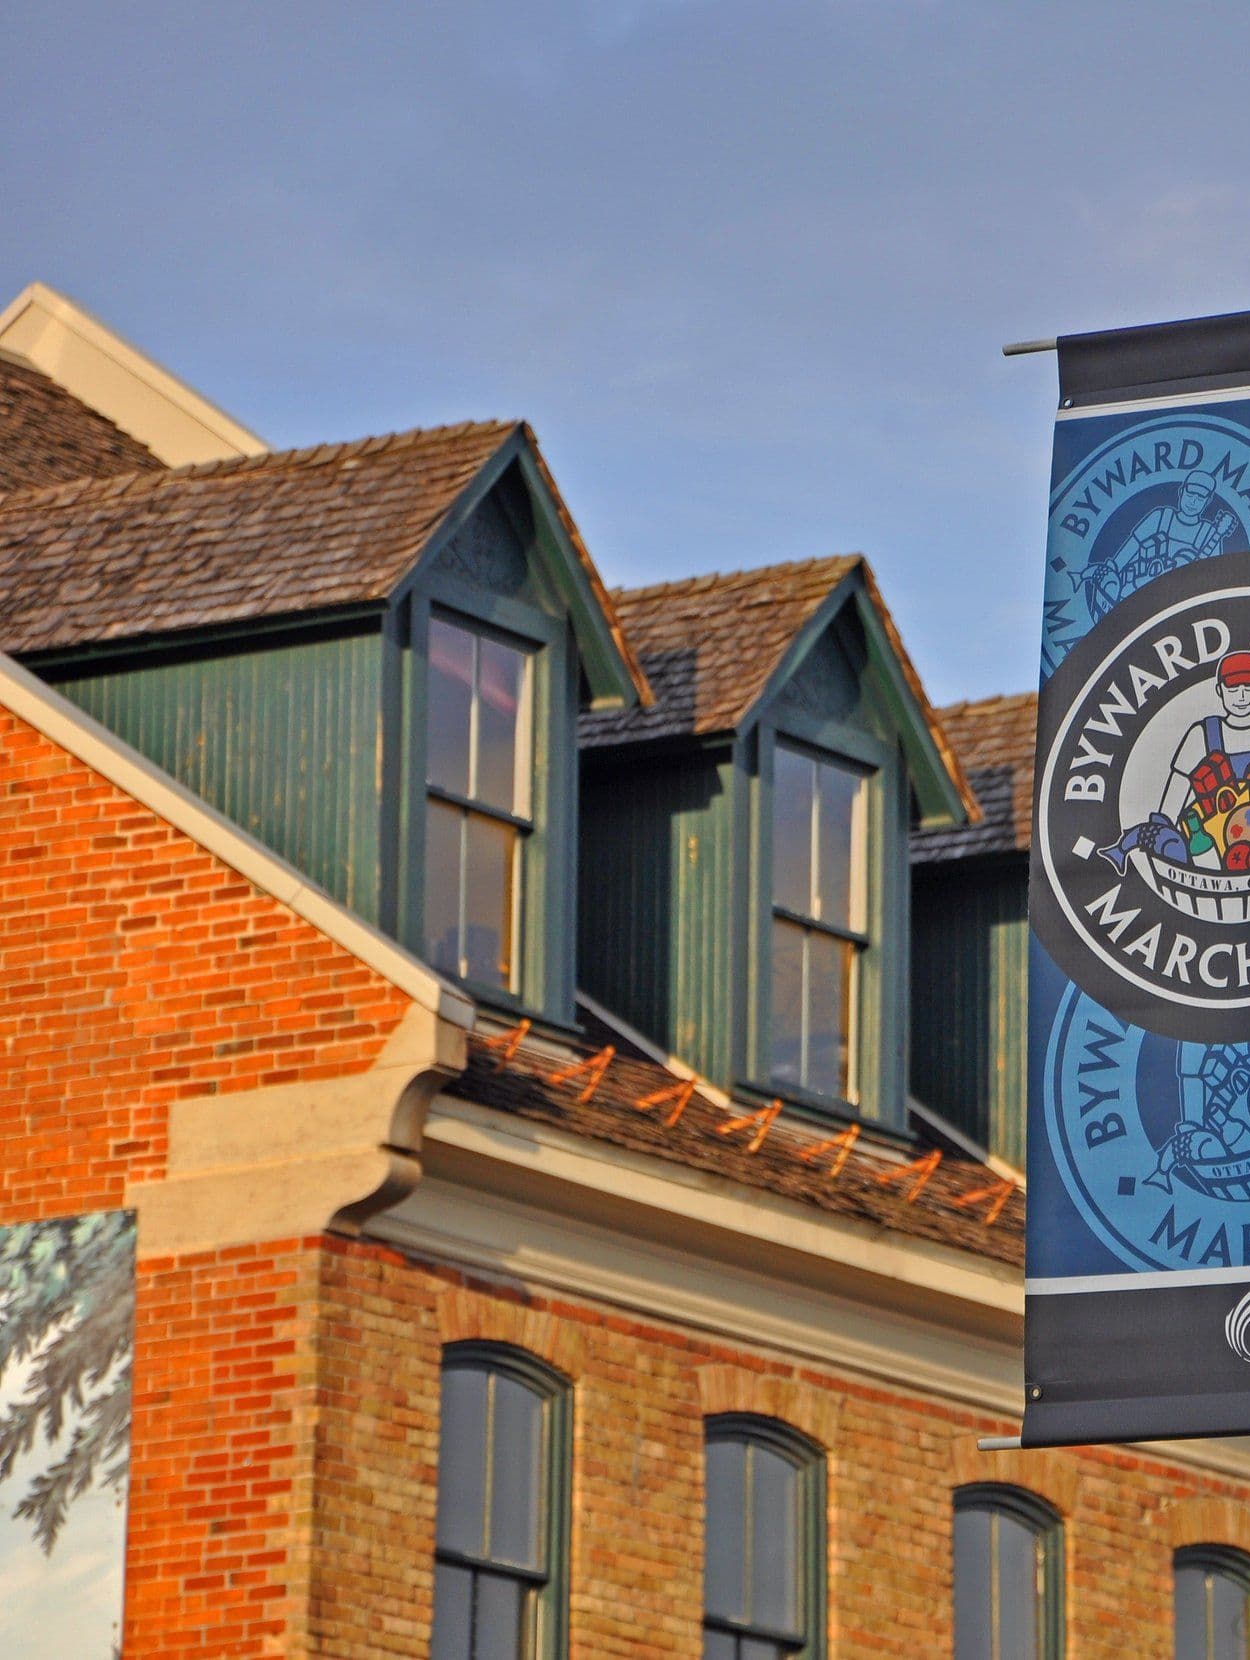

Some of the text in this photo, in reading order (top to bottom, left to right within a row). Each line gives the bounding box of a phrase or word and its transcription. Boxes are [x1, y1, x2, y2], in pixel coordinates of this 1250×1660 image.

[1060, 439, 1205, 539] BYWARD
[1065, 617, 1231, 803] BYWARD
[1167, 867, 1239, 893] OTTAWA,
[1077, 1012, 1129, 1151] BYW
